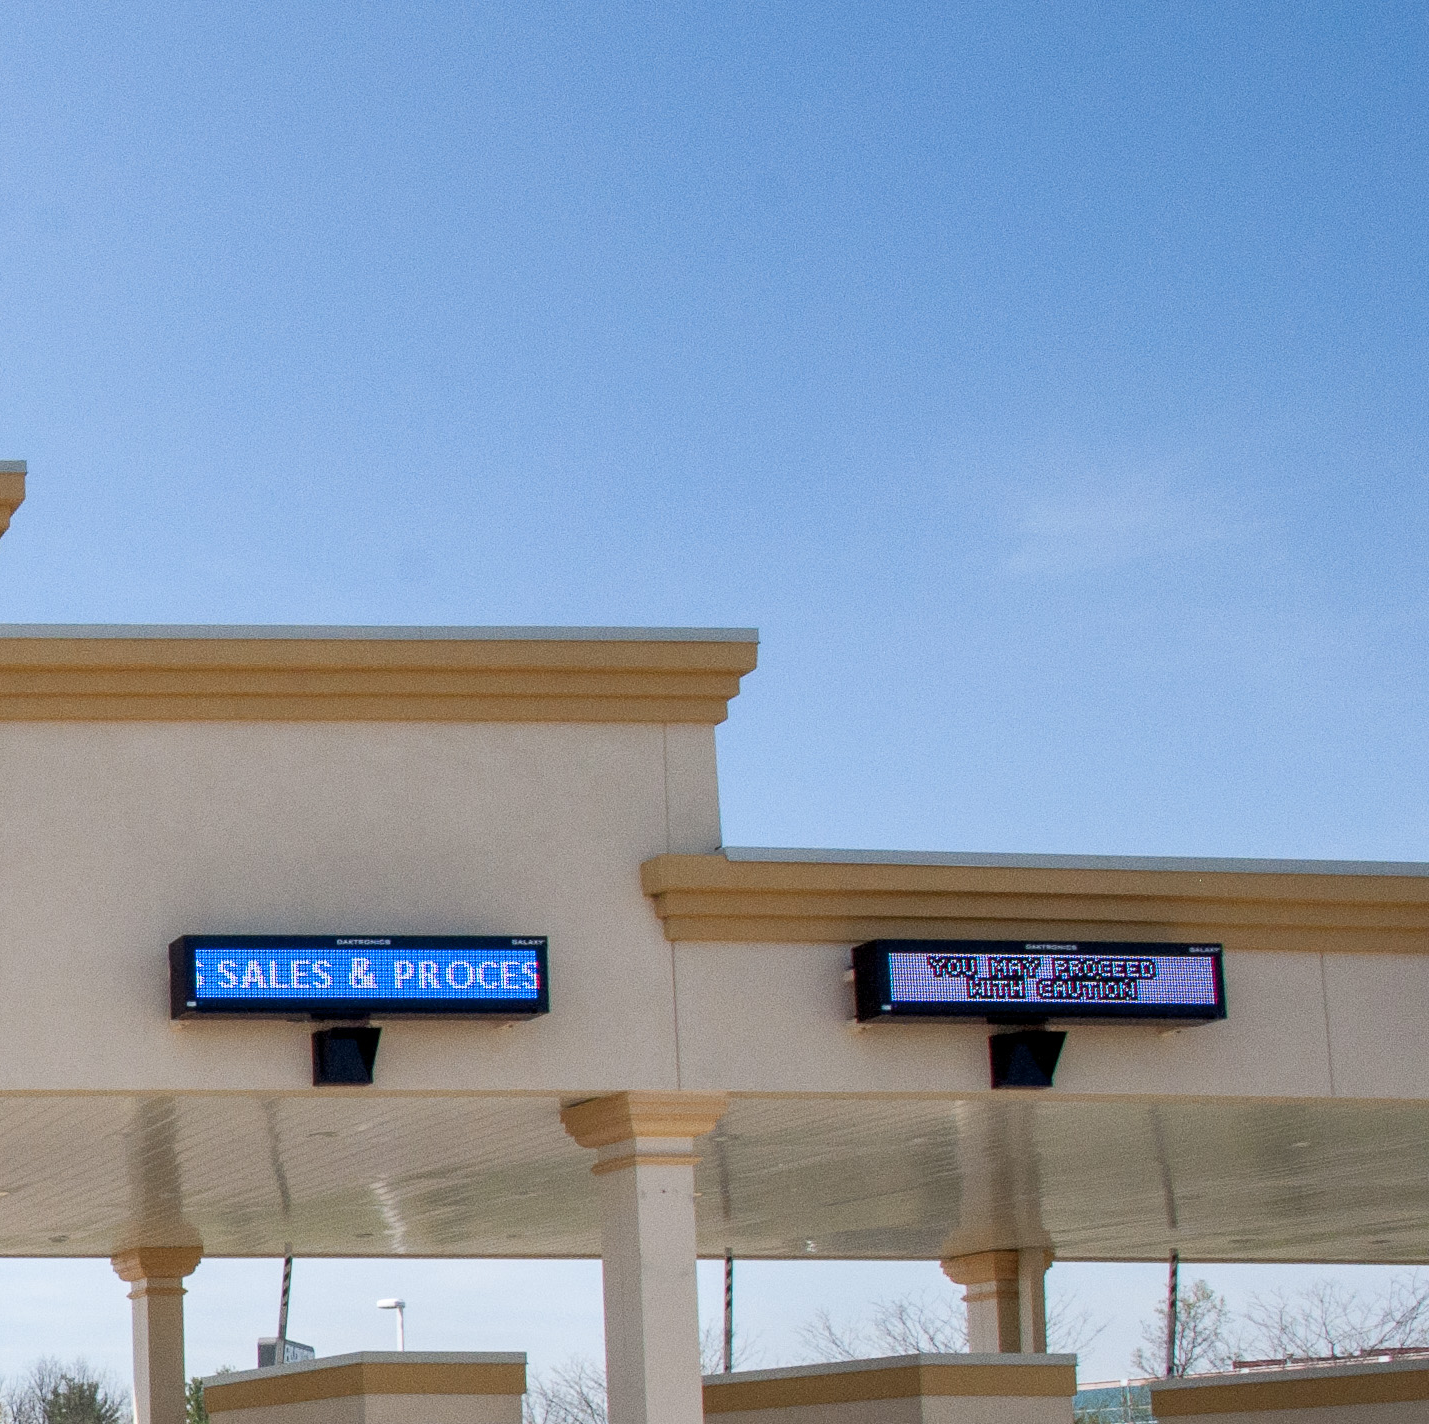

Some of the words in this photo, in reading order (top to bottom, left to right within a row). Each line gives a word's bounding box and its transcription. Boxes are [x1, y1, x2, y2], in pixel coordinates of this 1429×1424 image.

[217, 959, 333, 989] SALES
[349, 957, 378, 989] &
[394, 960, 540, 989] PROCES
[930, 956, 977, 975] YOU
[991, 957, 1041, 976] MAY
[1054, 959, 1156, 978] PROCEED
[969, 980, 1026, 998] WITH
[1038, 981, 1138, 998] CAUTION
